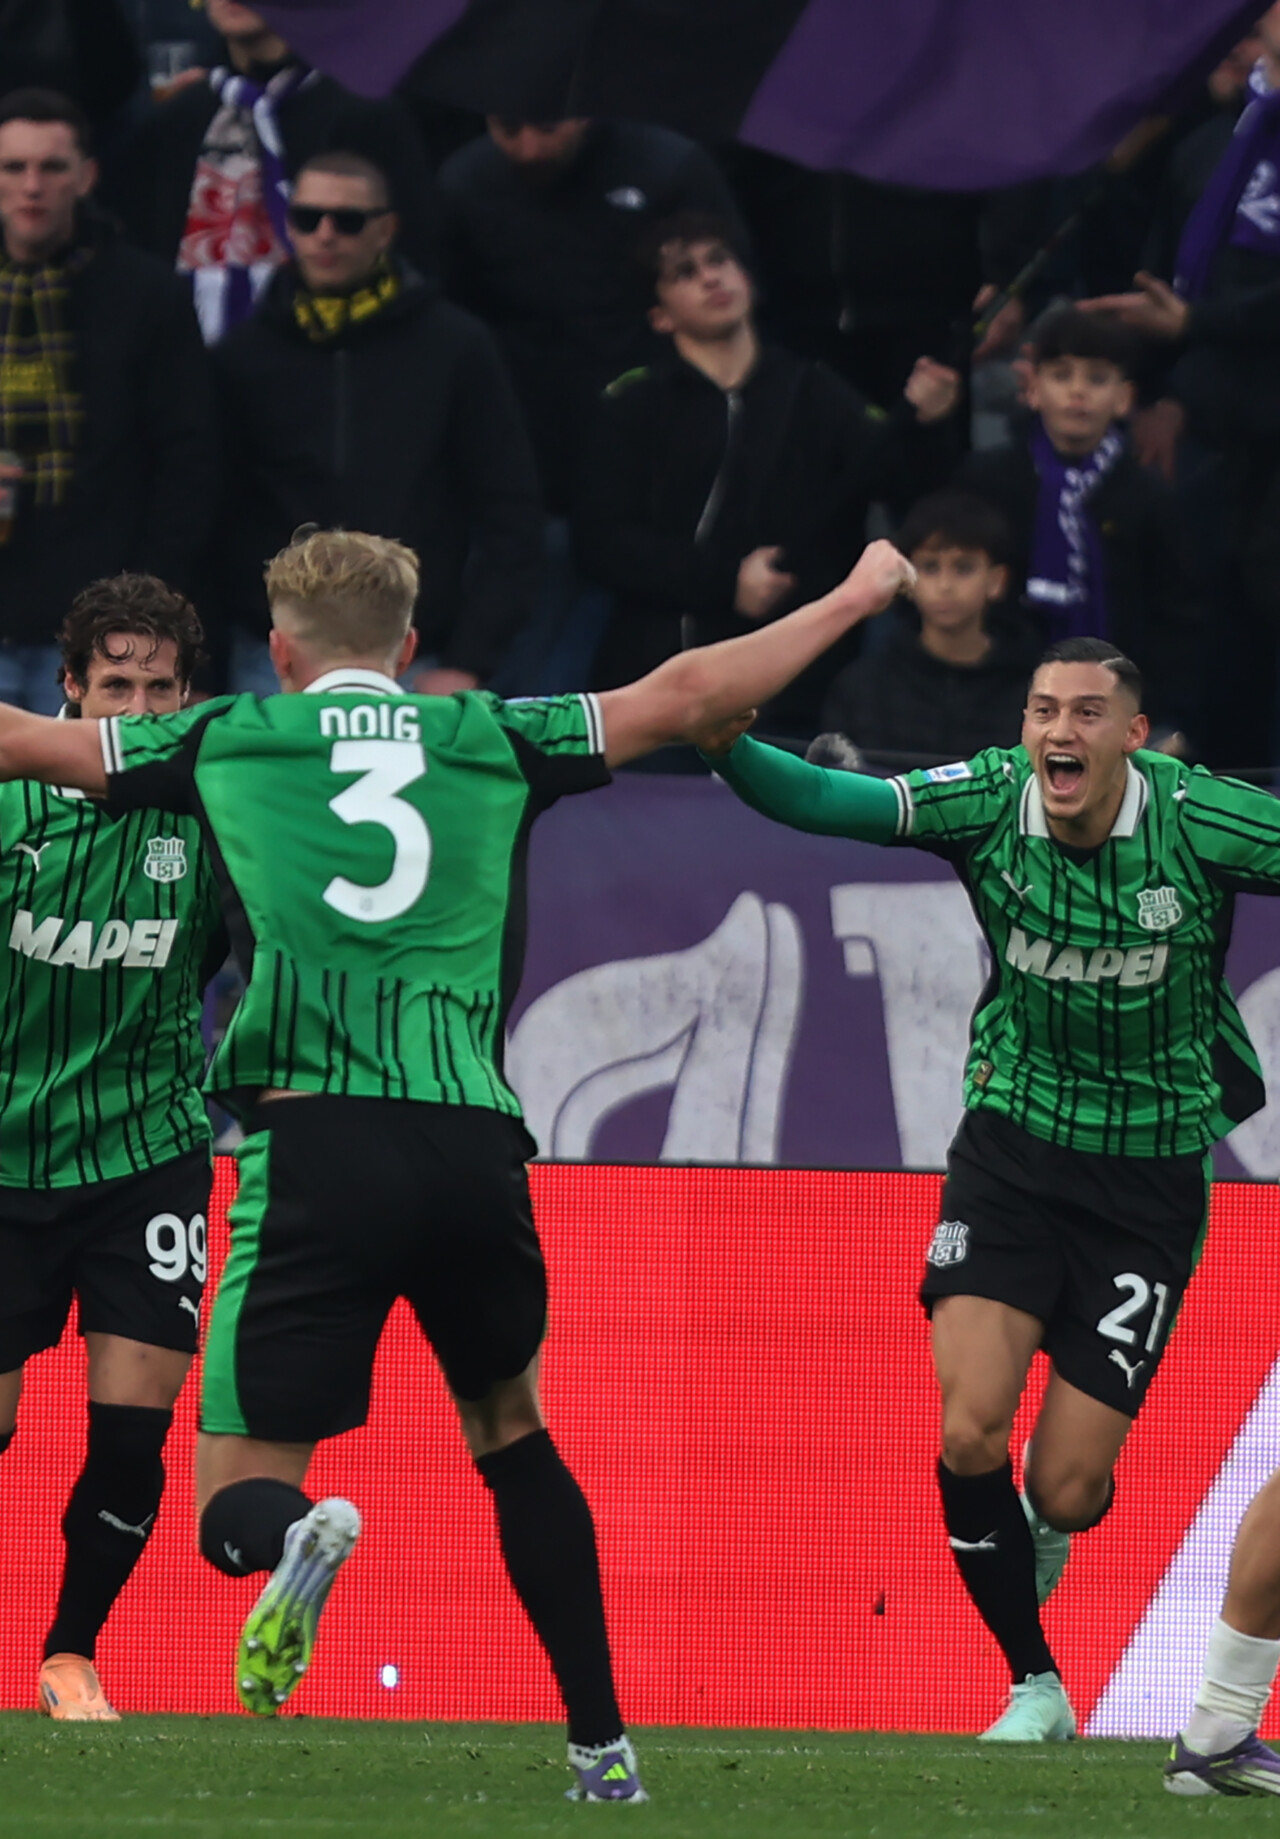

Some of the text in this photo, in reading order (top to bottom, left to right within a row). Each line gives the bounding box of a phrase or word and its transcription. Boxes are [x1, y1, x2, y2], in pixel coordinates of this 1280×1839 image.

[322, 739, 432, 923] 3
[8, 909, 179, 969] MAPEI
[1005, 926, 1169, 986] MAPEI
[145, 1212, 207, 1283] 99
[1096, 1272, 1167, 1352] 21
